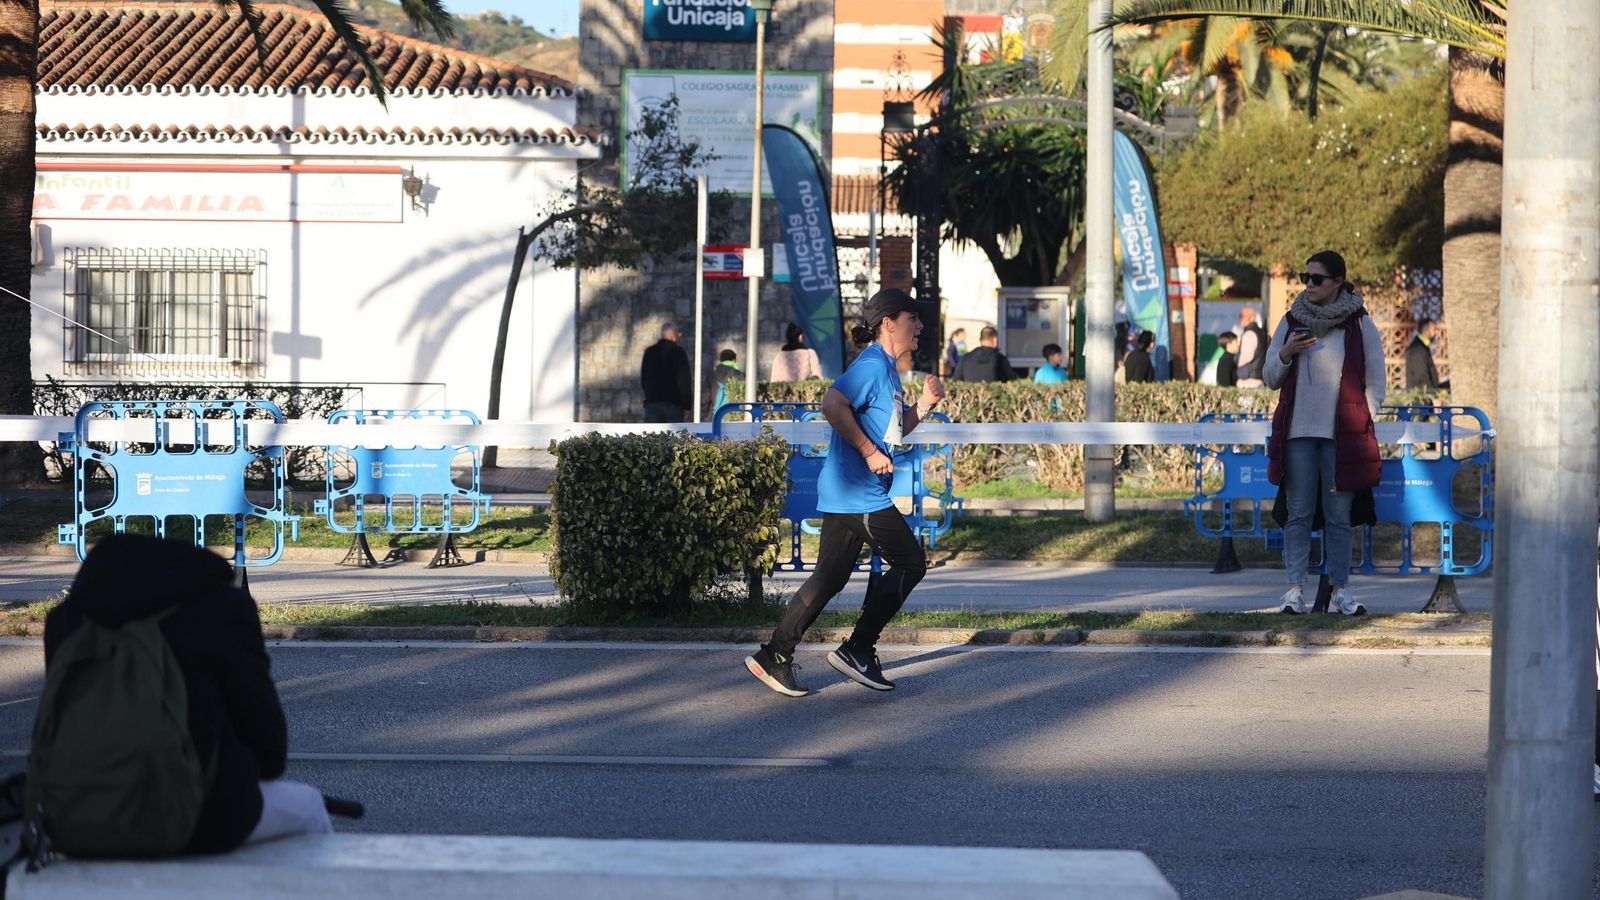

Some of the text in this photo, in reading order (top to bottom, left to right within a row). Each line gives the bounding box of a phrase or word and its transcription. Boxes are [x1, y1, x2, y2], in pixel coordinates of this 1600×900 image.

[667, 7, 744, 30] Unicaja
[681, 82, 810, 93] COLEGIO SAGRAA FAMILIA
[80, 194, 265, 212] FAMILIA
[154, 474, 195, 482] Ayuntamiento
[1411, 479, 1433, 487] Málaga
